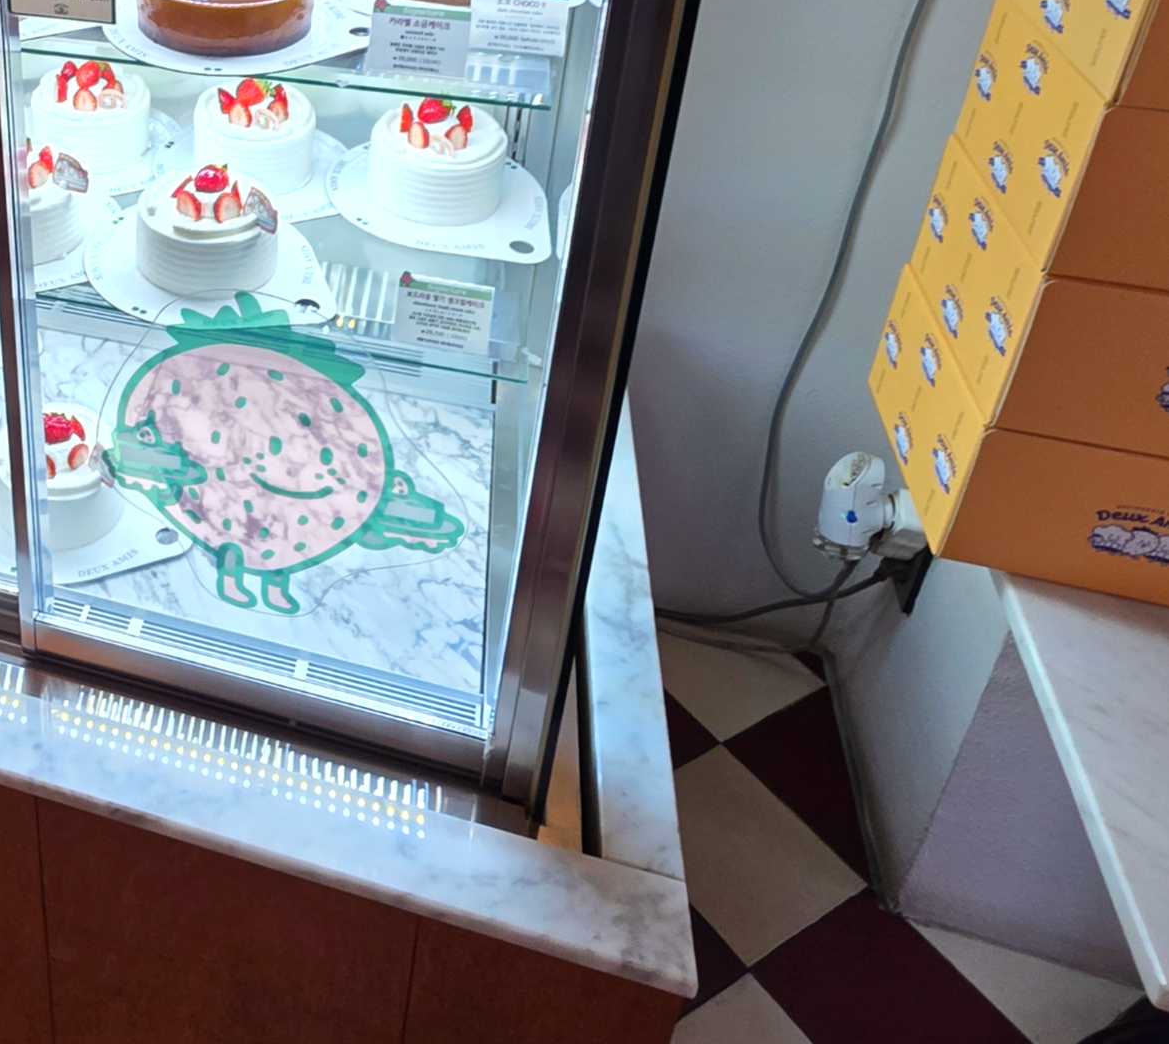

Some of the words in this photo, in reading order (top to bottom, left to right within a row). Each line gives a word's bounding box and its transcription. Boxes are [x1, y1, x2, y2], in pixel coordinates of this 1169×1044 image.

[389, 17, 411, 27] 카라멜
[413, 19, 450, 30] 소금케이크
[407, 290, 431, 300] 보드라운
[433, 294, 446, 303] 딸기
[447, 296, 486, 309] 생크림케이크
[1095, 509, 1150, 523] Deux
[77, 563, 110, 578] DEUX
[112, 547, 139, 568] AMIS
